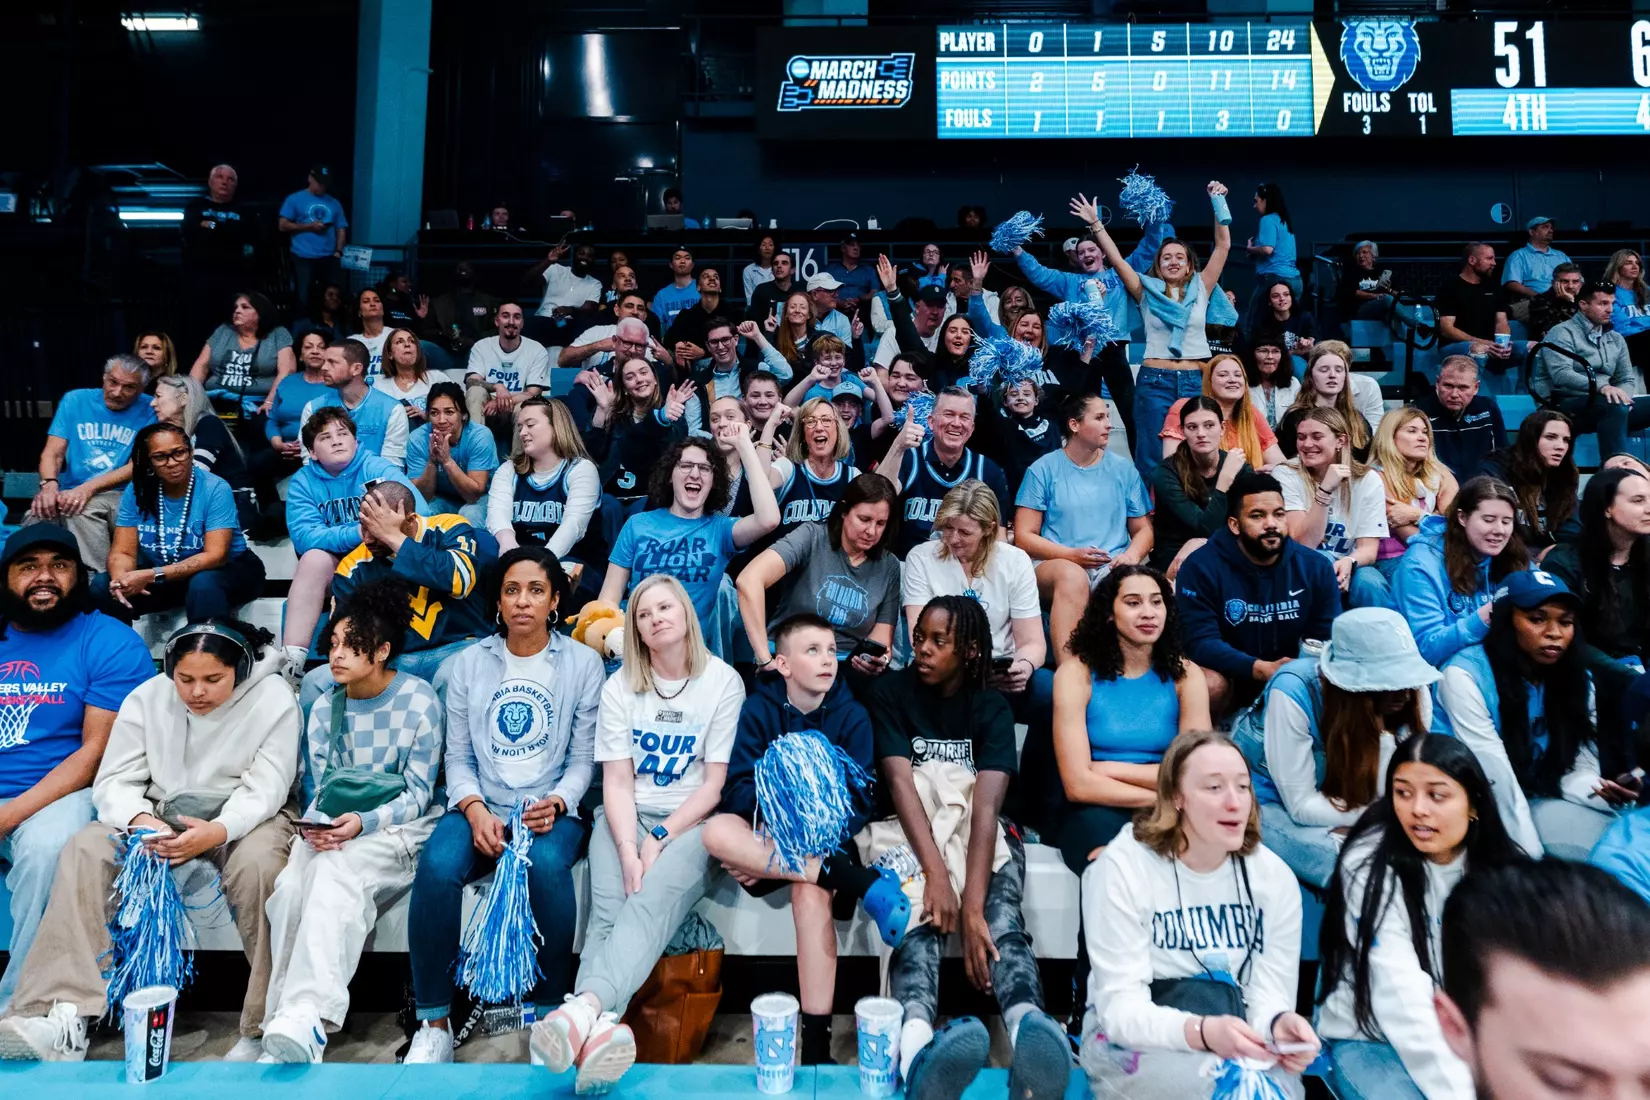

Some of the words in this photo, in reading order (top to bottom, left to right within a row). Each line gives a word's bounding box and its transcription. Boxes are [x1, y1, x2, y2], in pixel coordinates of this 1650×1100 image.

[940, 32, 996, 52] PLAYER
[1028, 31, 1044, 53] 0
[1093, 31, 1102, 53] 1
[1151, 30, 1166, 52] 5
[1208, 29, 1234, 51] 10
[1266, 29, 1296, 51] 24
[1494, 20, 1547, 88] 51
[809, 60, 877, 79] MARCH
[817, 80, 909, 99] MADNESS
[940, 71, 996, 91] POINTS
[1029, 72, 1044, 92] 2
[1152, 71, 1167, 91] 0
[1209, 70, 1232, 91] 11
[1271, 69, 1297, 90] 14
[1343, 92, 1391, 113] FOULS
[1407, 92, 1437, 113] TOL
[1502, 93, 1548, 131] 4TH
[945, 108, 993, 128] FOULS
[1032, 111, 1042, 132] 1
[1095, 110, 1104, 132] 1
[1157, 110, 1166, 131] 1
[1215, 109, 1230, 131] 3
[1276, 109, 1292, 131] 0
[1362, 114, 1372, 135] 3
[1418, 114, 1427, 134] 1
[230, 350, 253, 365] YOU
[225, 363, 251, 375] GOT
[488, 368, 519, 381] FOUR
[221, 374, 252, 387] THIS
[77, 422, 136, 446] COLUMBI
[513, 500, 564, 524] LUMBI
[904, 497, 943, 522] COLU
[643, 537, 707, 554] ROAR
[643, 552, 703, 568] LION
[1249, 611, 1300, 624] BASKEBALL
[22, 682, 68, 692] VALLEY
[512, 685, 555, 728] BASKETBALL
[632, 728, 697, 755] FOUR
[501, 748, 527, 757] LION
[1152, 904, 1264, 954] COLUMBIA
